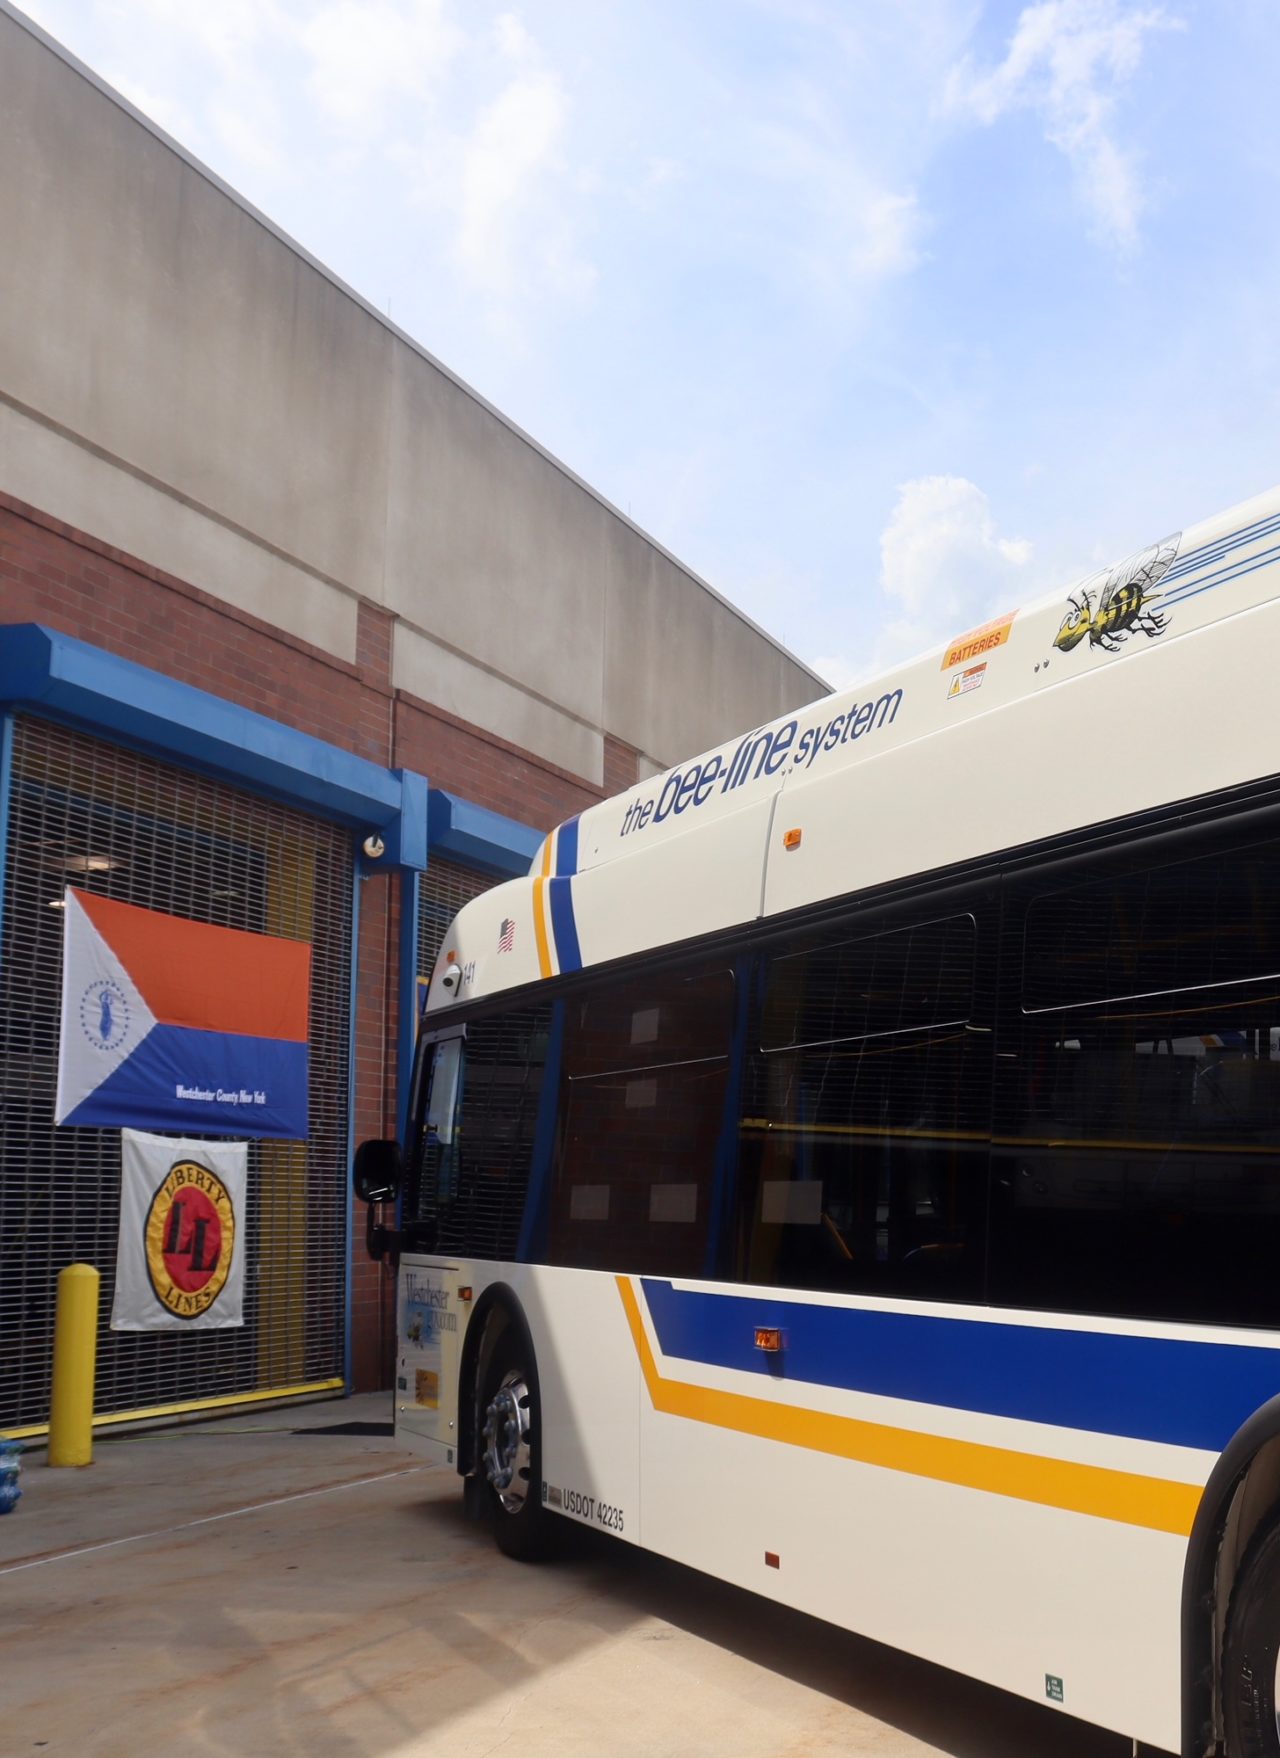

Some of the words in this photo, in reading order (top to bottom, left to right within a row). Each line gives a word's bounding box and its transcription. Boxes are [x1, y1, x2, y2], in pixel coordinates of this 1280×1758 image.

[948, 631, 1001, 666] BATTERIES
[620, 798, 654, 836] the
[652, 720, 798, 823] bee-line
[794, 688, 903, 768] system
[176, 1084, 216, 1101] Westchester
[239, 1089, 253, 1104] New
[253, 1090, 266, 1104] York
[165, 1167, 225, 1205] LIBERTY
[164, 1286, 212, 1312] LINES
[405, 1273, 450, 1310] Westchester
[563, 1488, 595, 1520] USDOT
[597, 1501, 624, 1532] 42235
